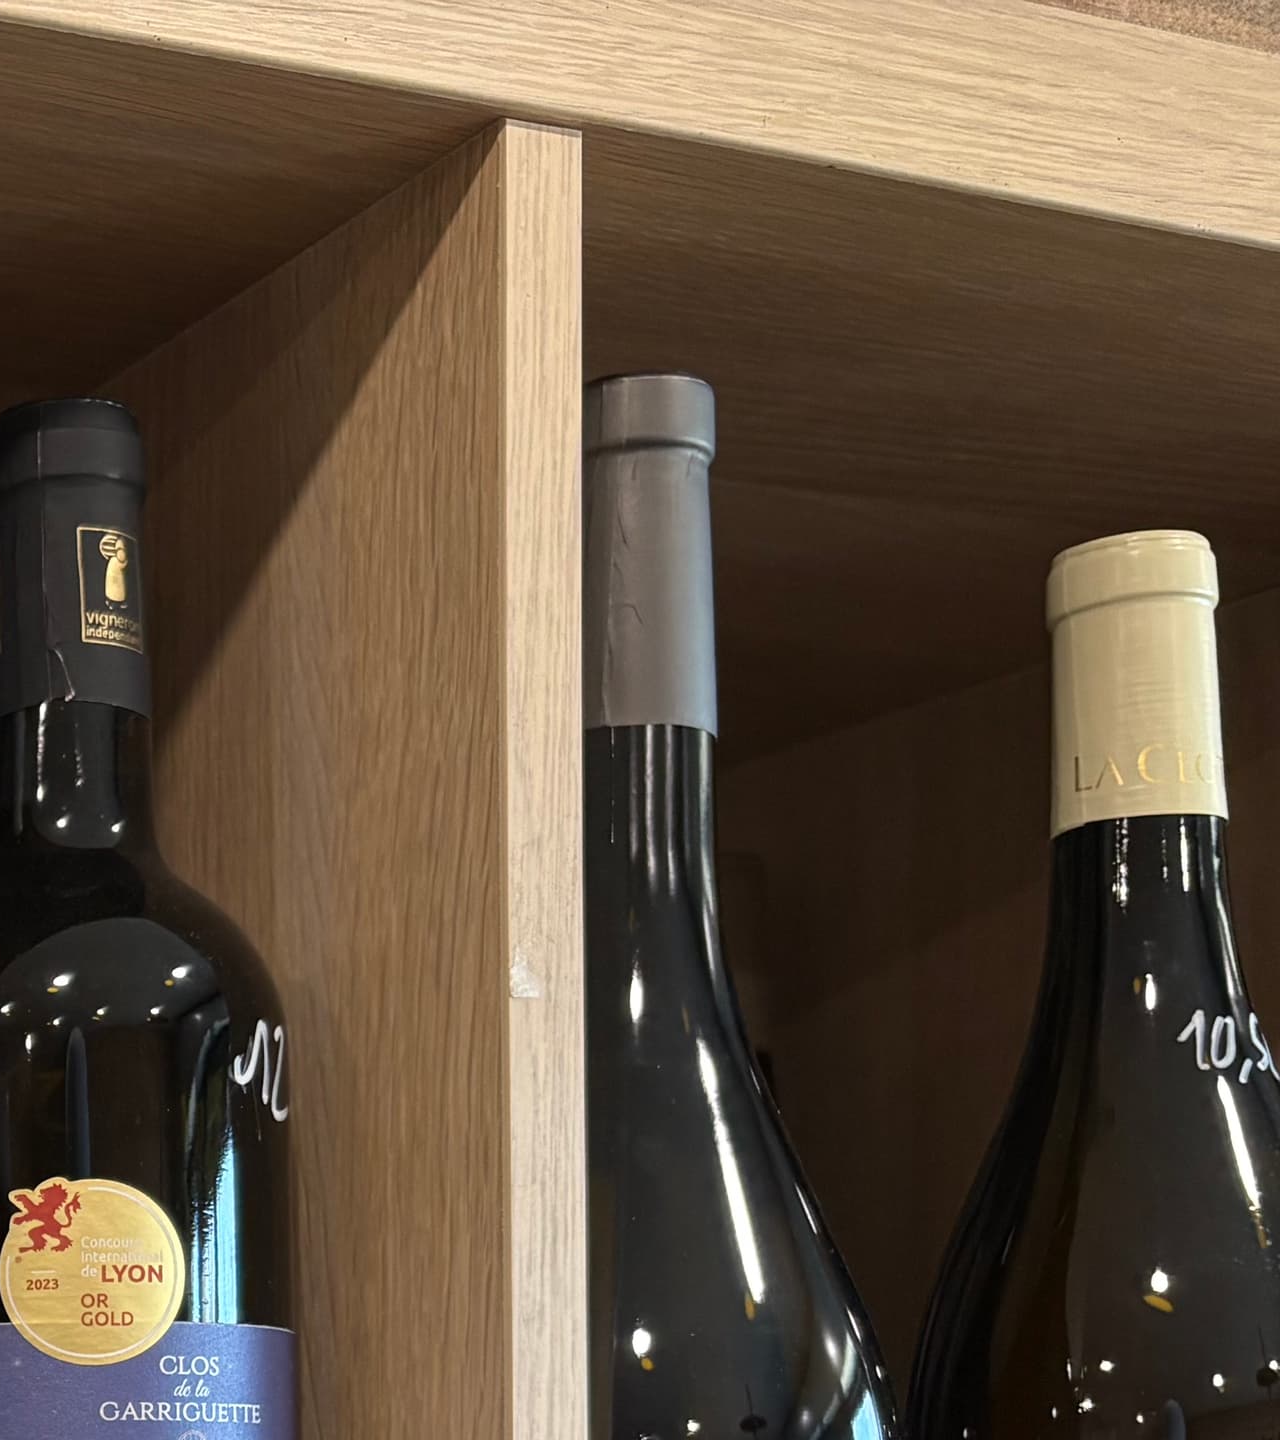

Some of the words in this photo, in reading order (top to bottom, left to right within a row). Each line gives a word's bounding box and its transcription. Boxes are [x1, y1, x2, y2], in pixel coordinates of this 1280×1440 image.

[80, 1265, 97, 1278] de
[101, 1265, 163, 1283] LYON
[25, 1279, 59, 1291] 2023
[81, 1293, 108, 1309] OR
[81, 1312, 134, 1327] GOLD
[159, 1355, 220, 1377] CLOS
[173, 1379, 191, 1397] de
[195, 1379, 210, 1397] la
[99, 1402, 261, 1424] GARRIGUETTE
